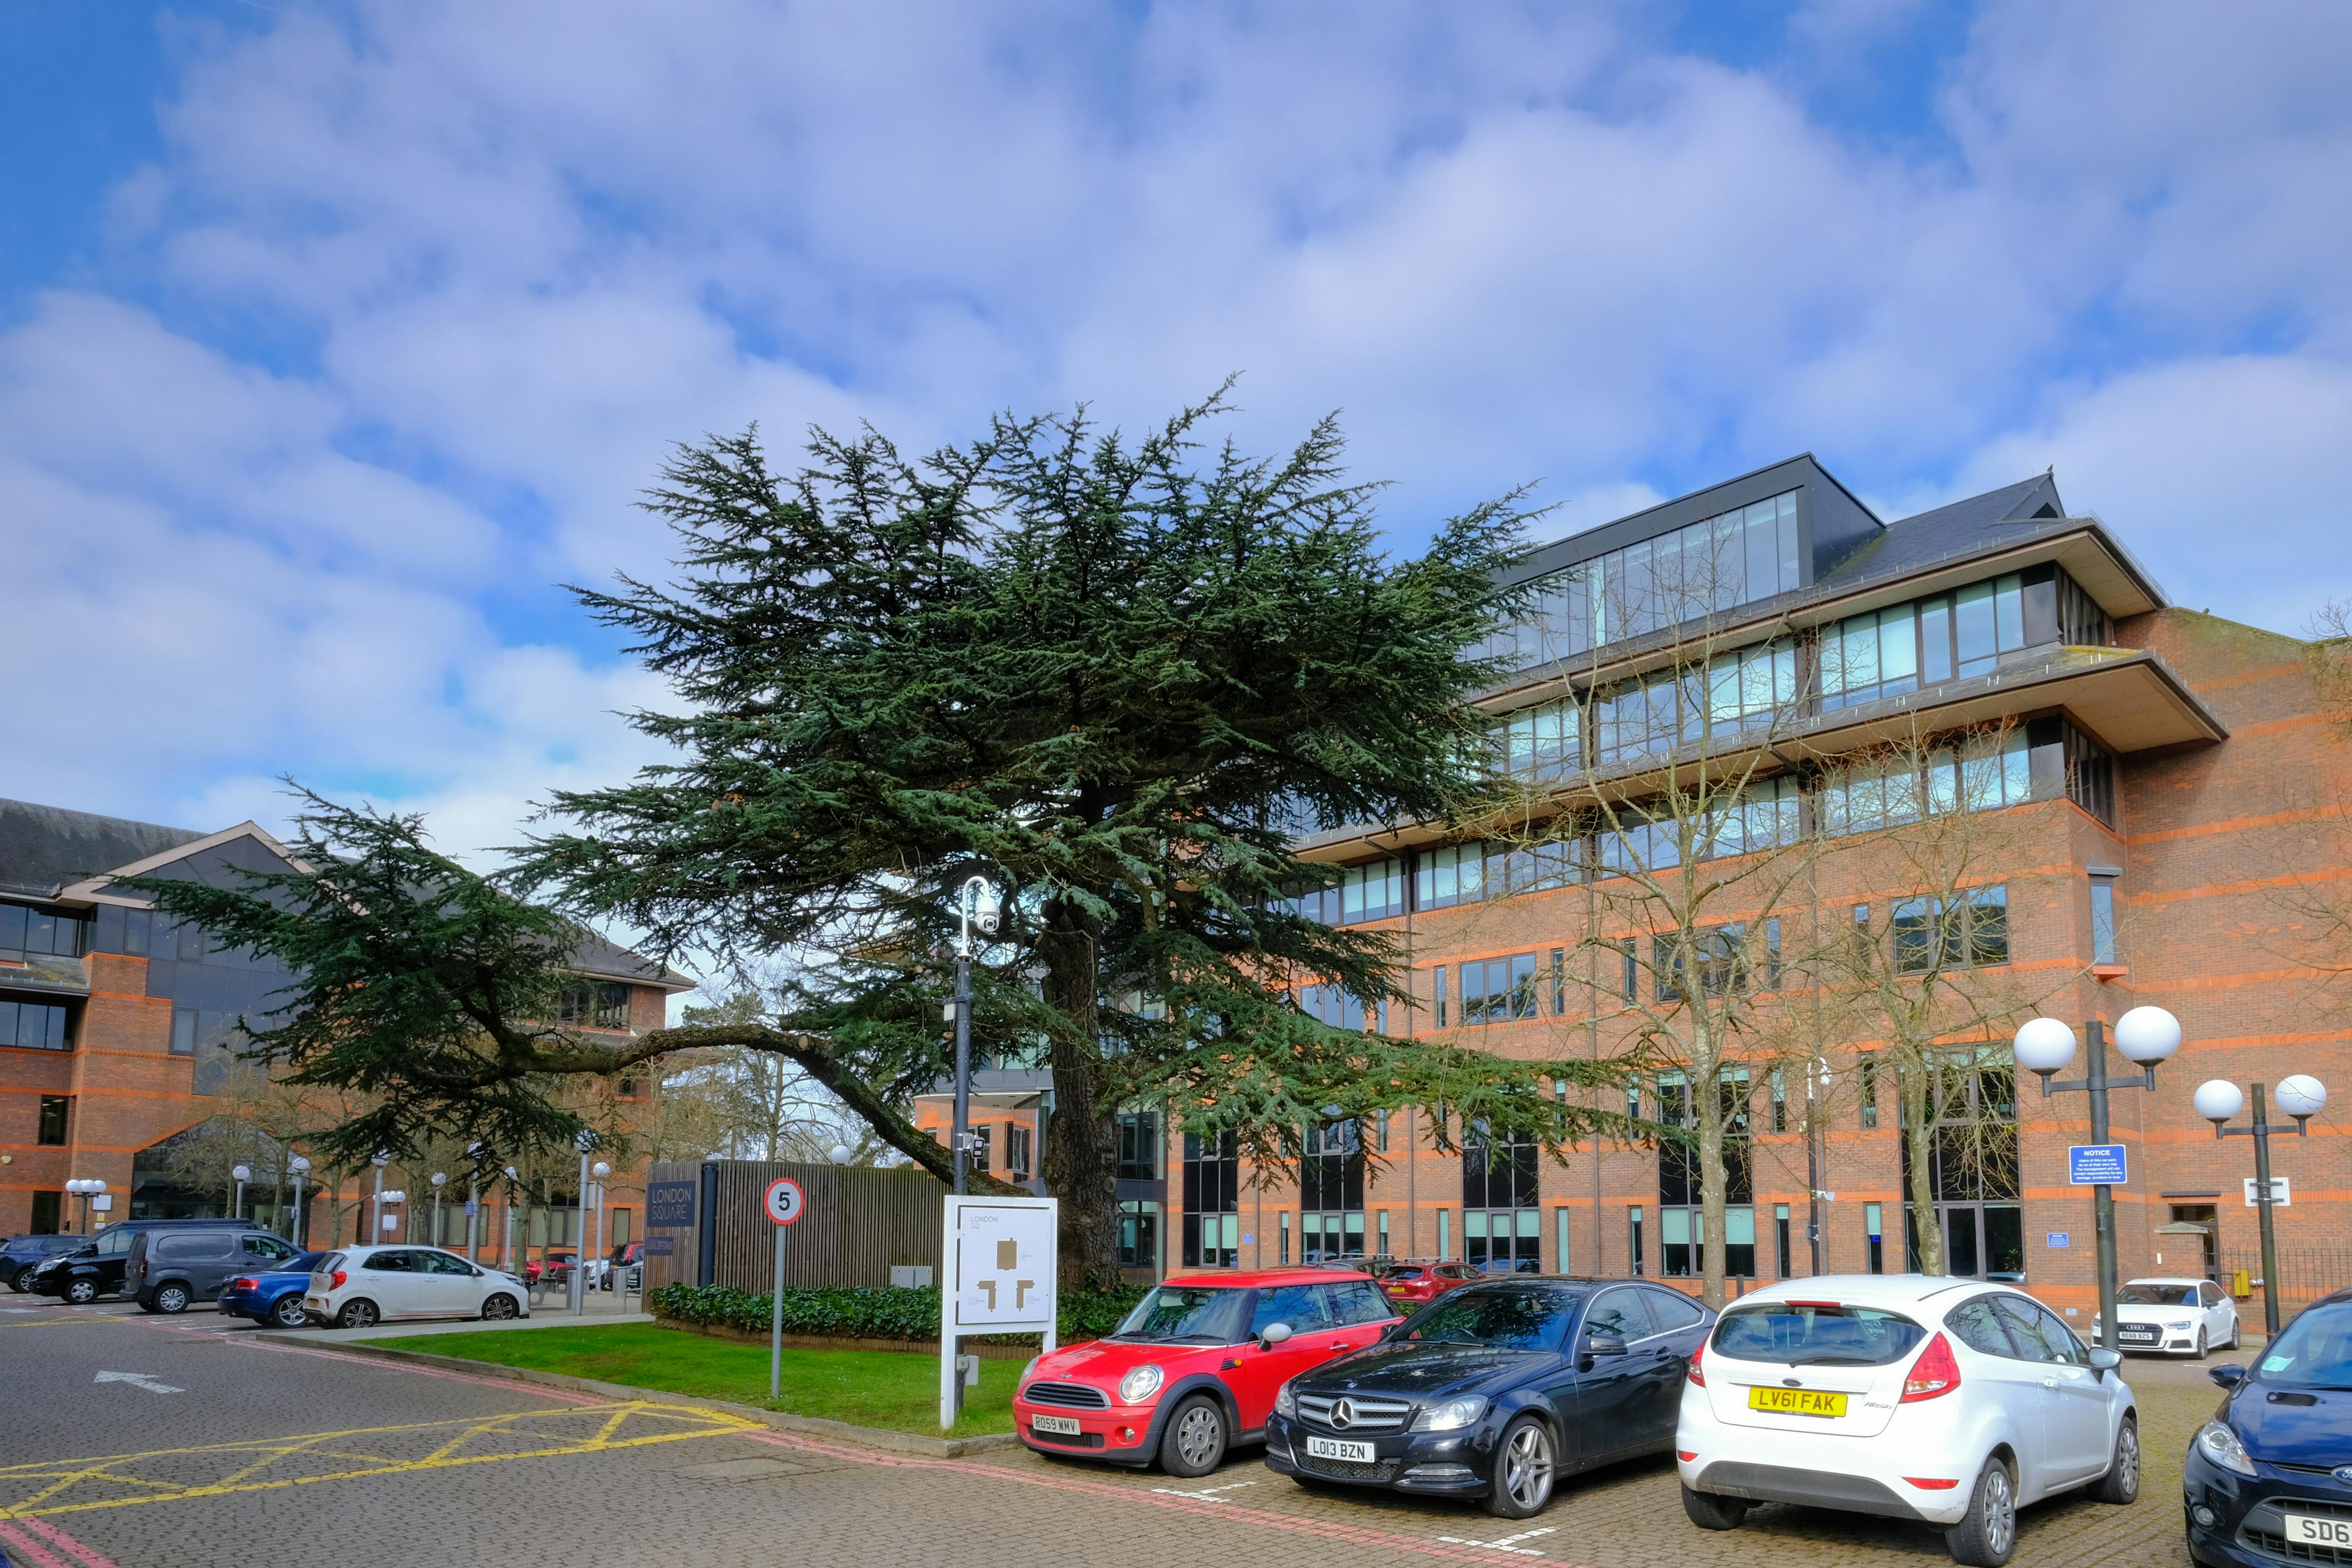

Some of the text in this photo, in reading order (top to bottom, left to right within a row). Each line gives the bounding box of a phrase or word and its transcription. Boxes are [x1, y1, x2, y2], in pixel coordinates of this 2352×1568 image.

[652, 1188, 691, 1203] LONDON
[779, 1192, 790, 1211] 5
[651, 1205, 687, 1220] SQUARE
[1759, 1390, 1835, 1411] LV61 FAK
[1035, 1416, 1075, 1432] RO59 WMV
[1313, 1440, 1365, 1459] LO13 BZN
[2302, 1520, 2352, 1543] SD6
